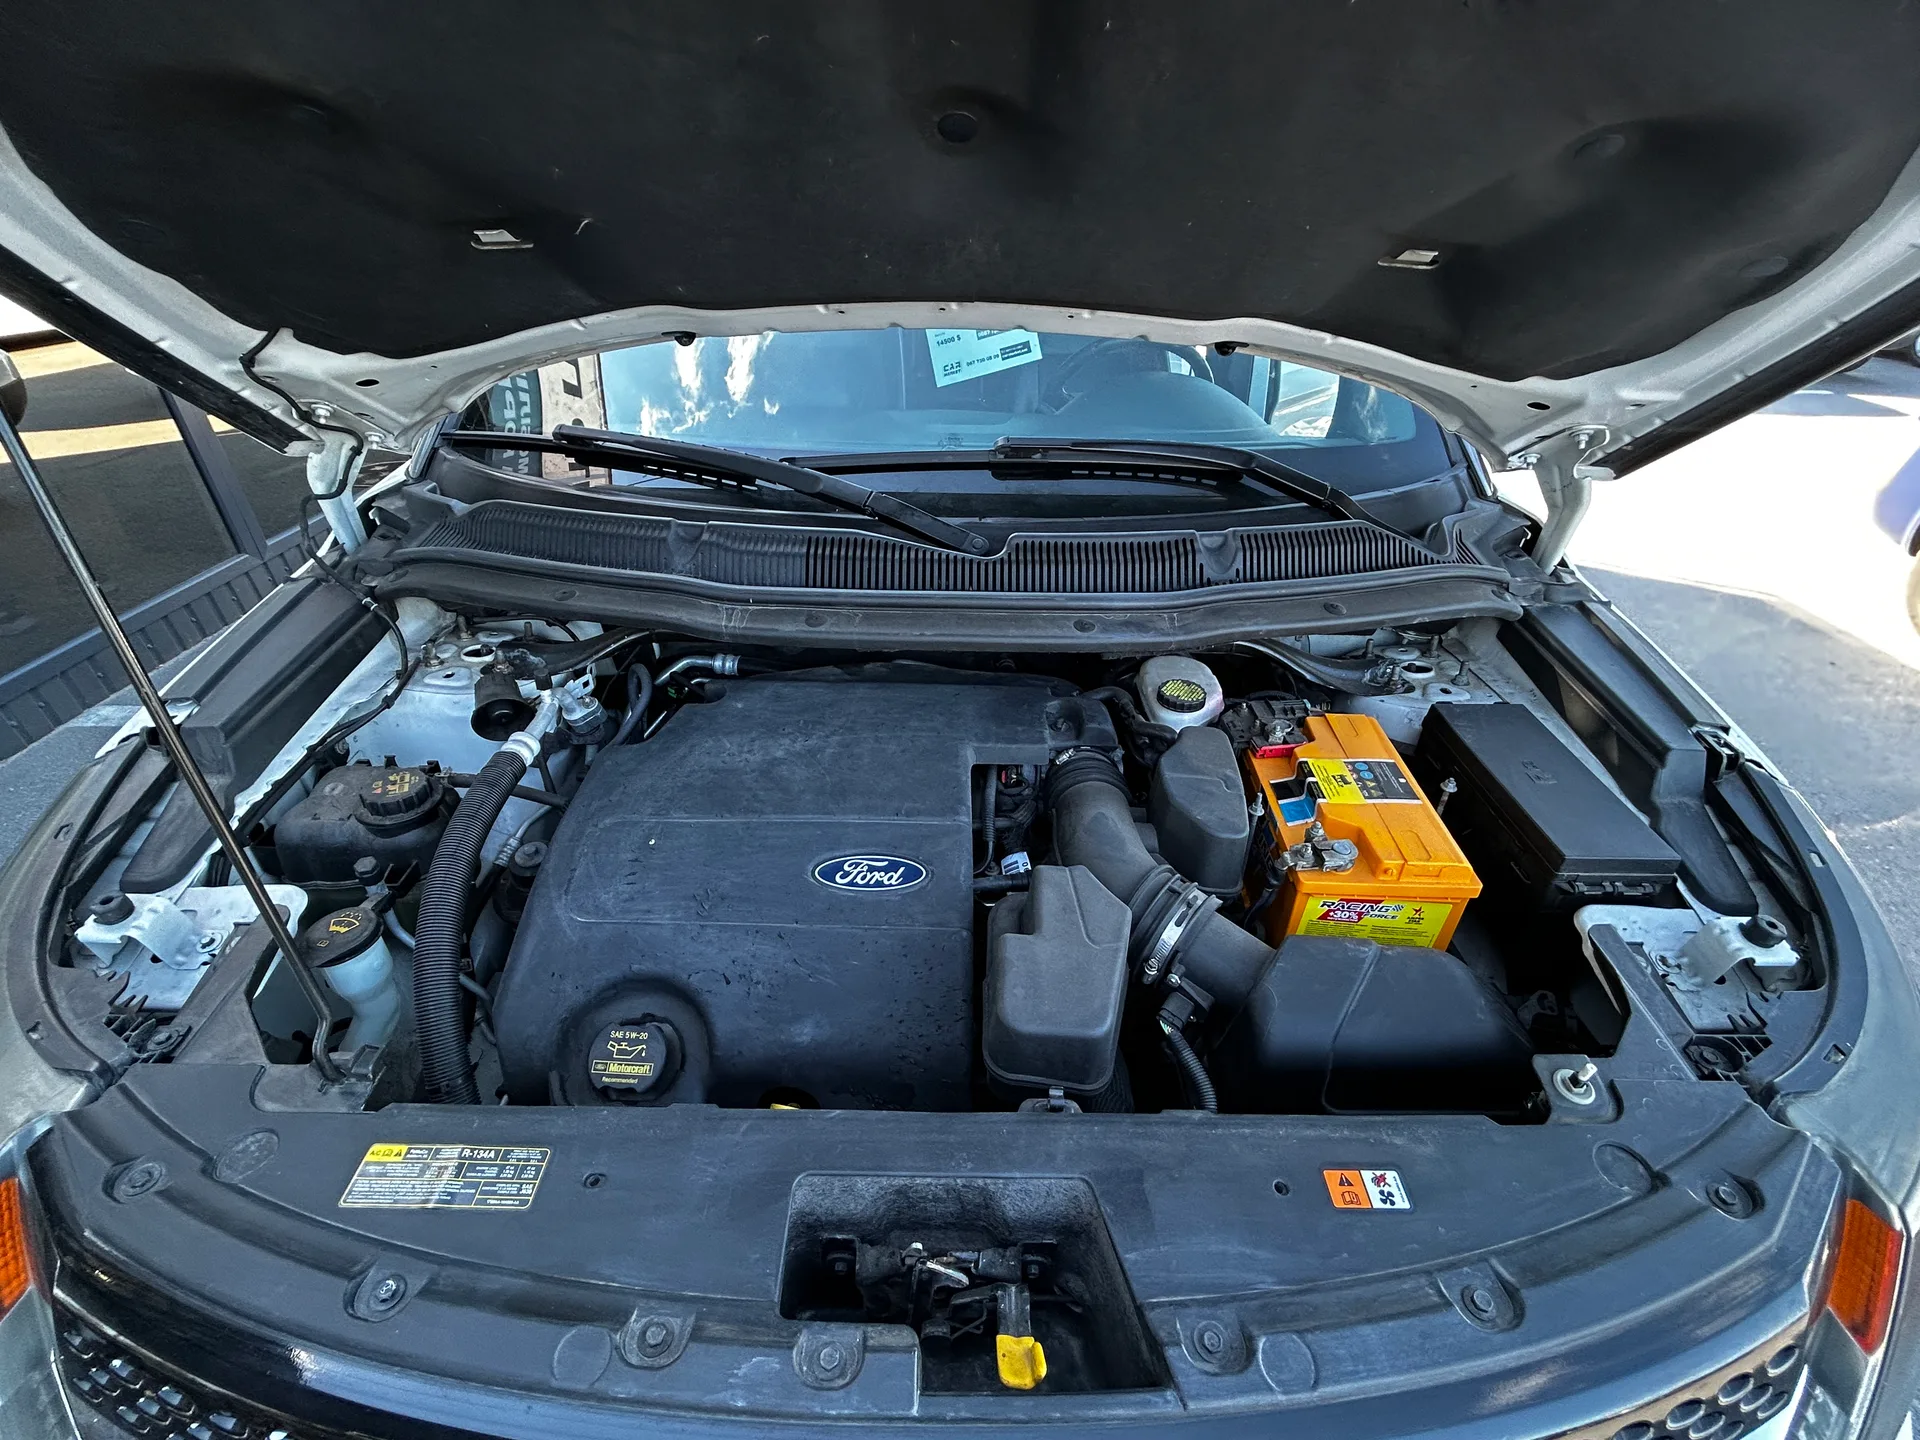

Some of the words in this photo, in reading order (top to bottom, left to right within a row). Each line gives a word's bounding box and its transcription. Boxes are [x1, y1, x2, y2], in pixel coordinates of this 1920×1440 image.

[936, 336, 955, 346] 14500
[835, 860, 906, 885] Ford
[1318, 900, 1394, 913] RACING
[1329, 910, 1359, 920] +30%
[1361, 912, 1399, 920] FORCE
[610, 1030, 625, 1039] SAE
[625, 1031, 649, 1040] 5W-20
[609, 1063, 650, 1074] Motorcraft
[601, 1076, 638, 1084] Recommended
[461, 1149, 496, 1159] R-134A
